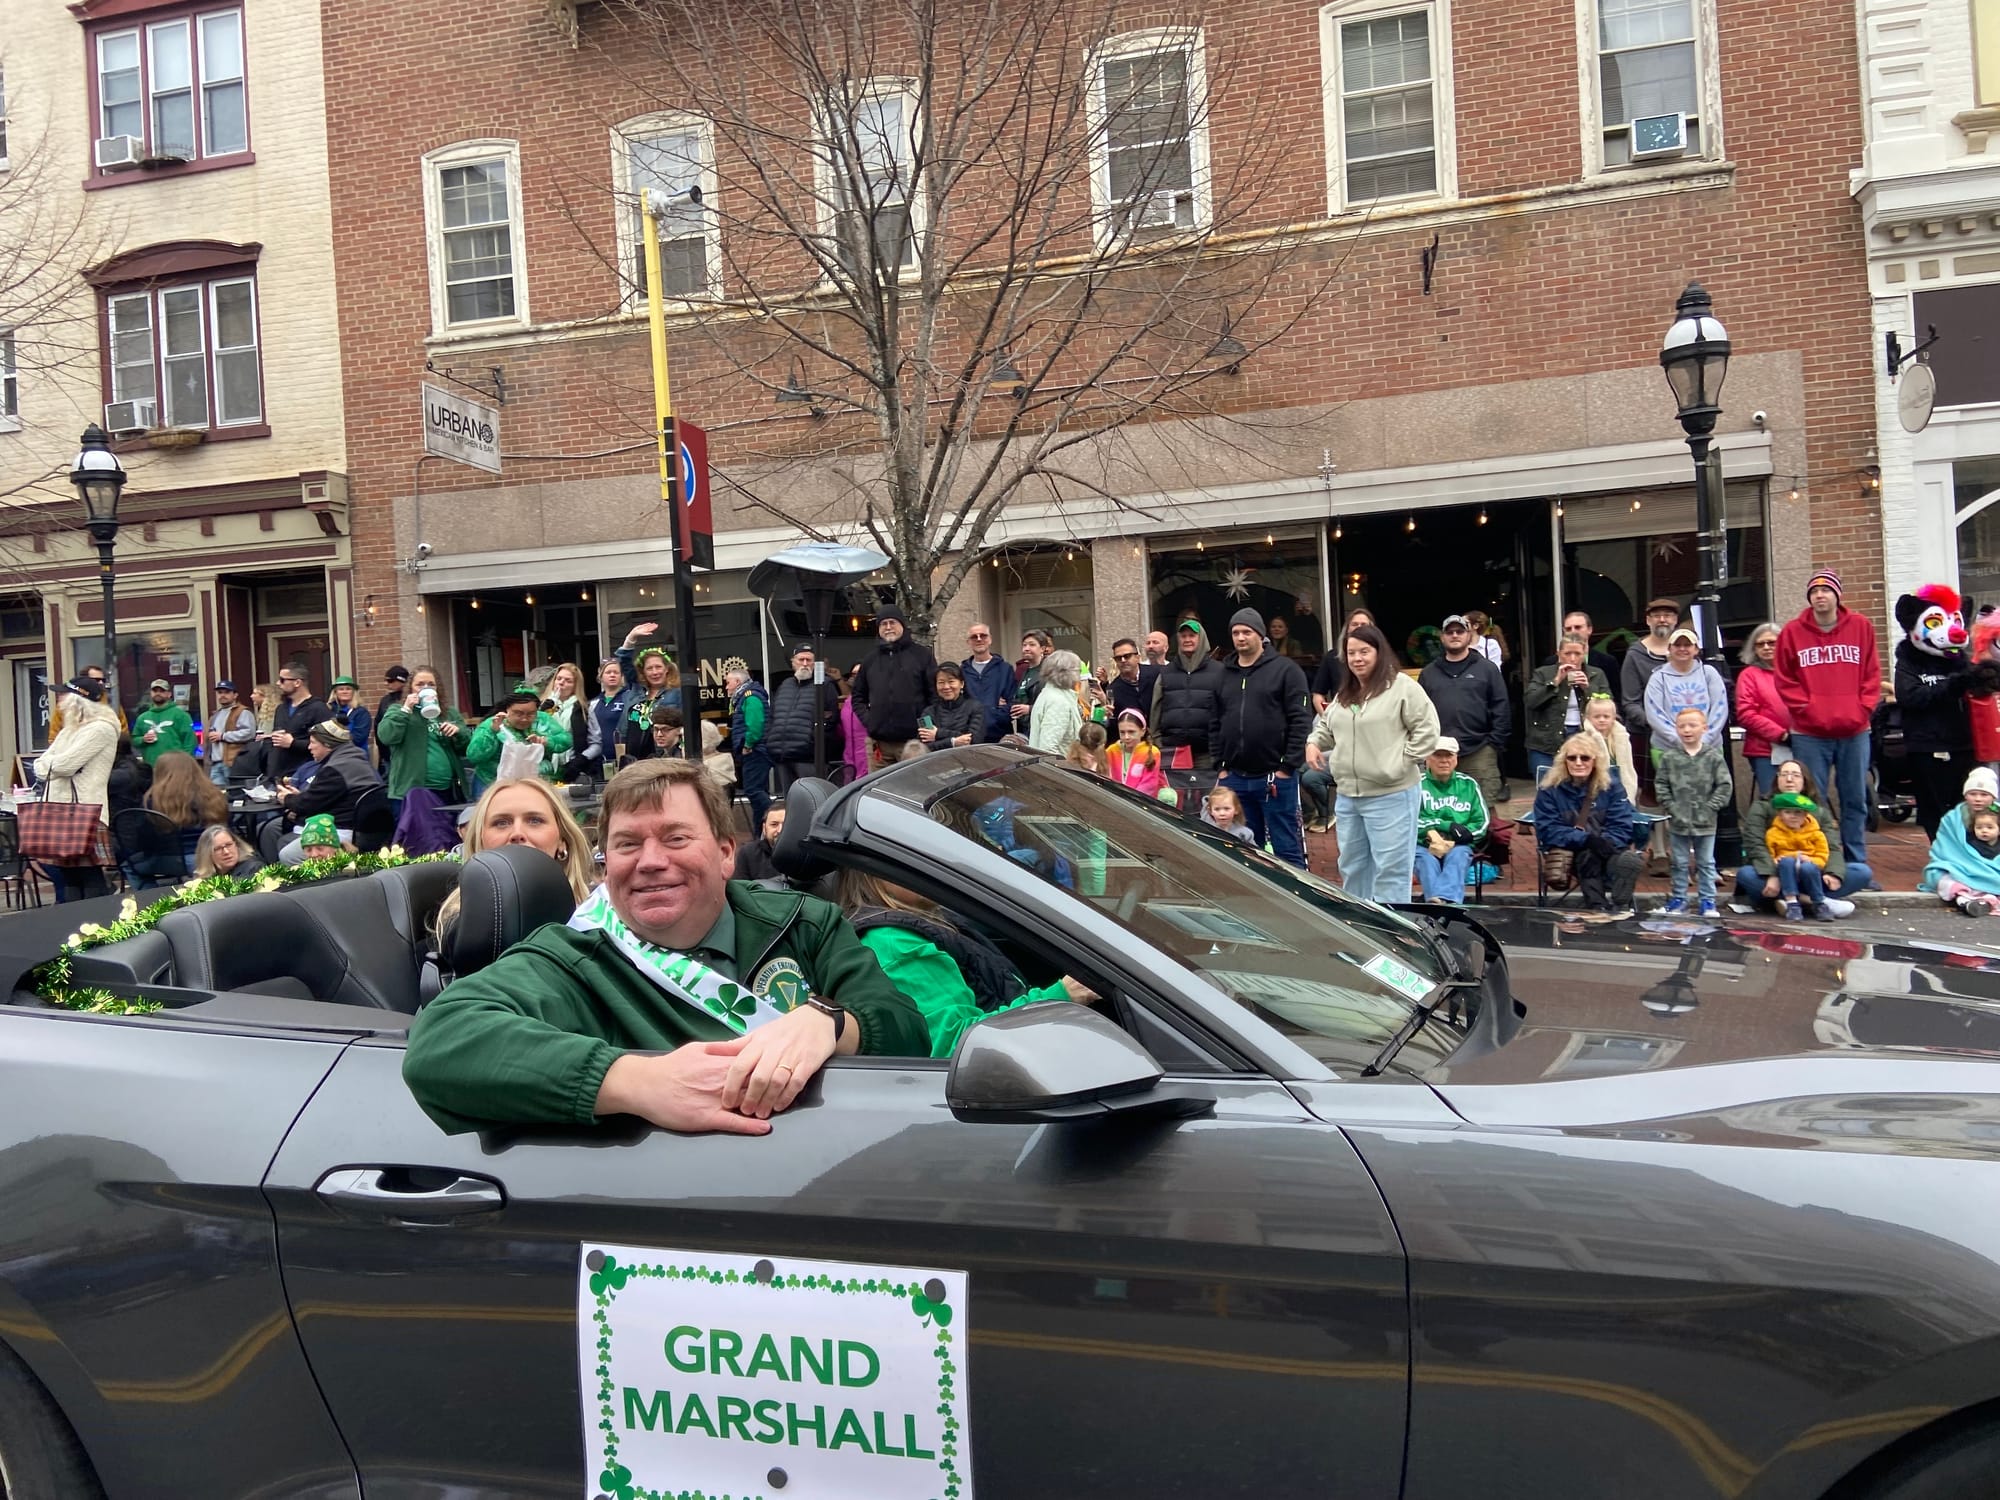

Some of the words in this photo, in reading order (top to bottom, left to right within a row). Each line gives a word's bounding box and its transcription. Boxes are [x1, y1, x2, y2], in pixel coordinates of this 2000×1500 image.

[431, 403, 493, 444] URBANO
[1798, 645, 1860, 667] TEMPLE
[1422, 790, 1471, 811] Phillies
[756, 964, 778, 993] OPERATING
[664, 1325, 880, 1388] GRAND
[623, 1387, 935, 1460] MARSHALL
